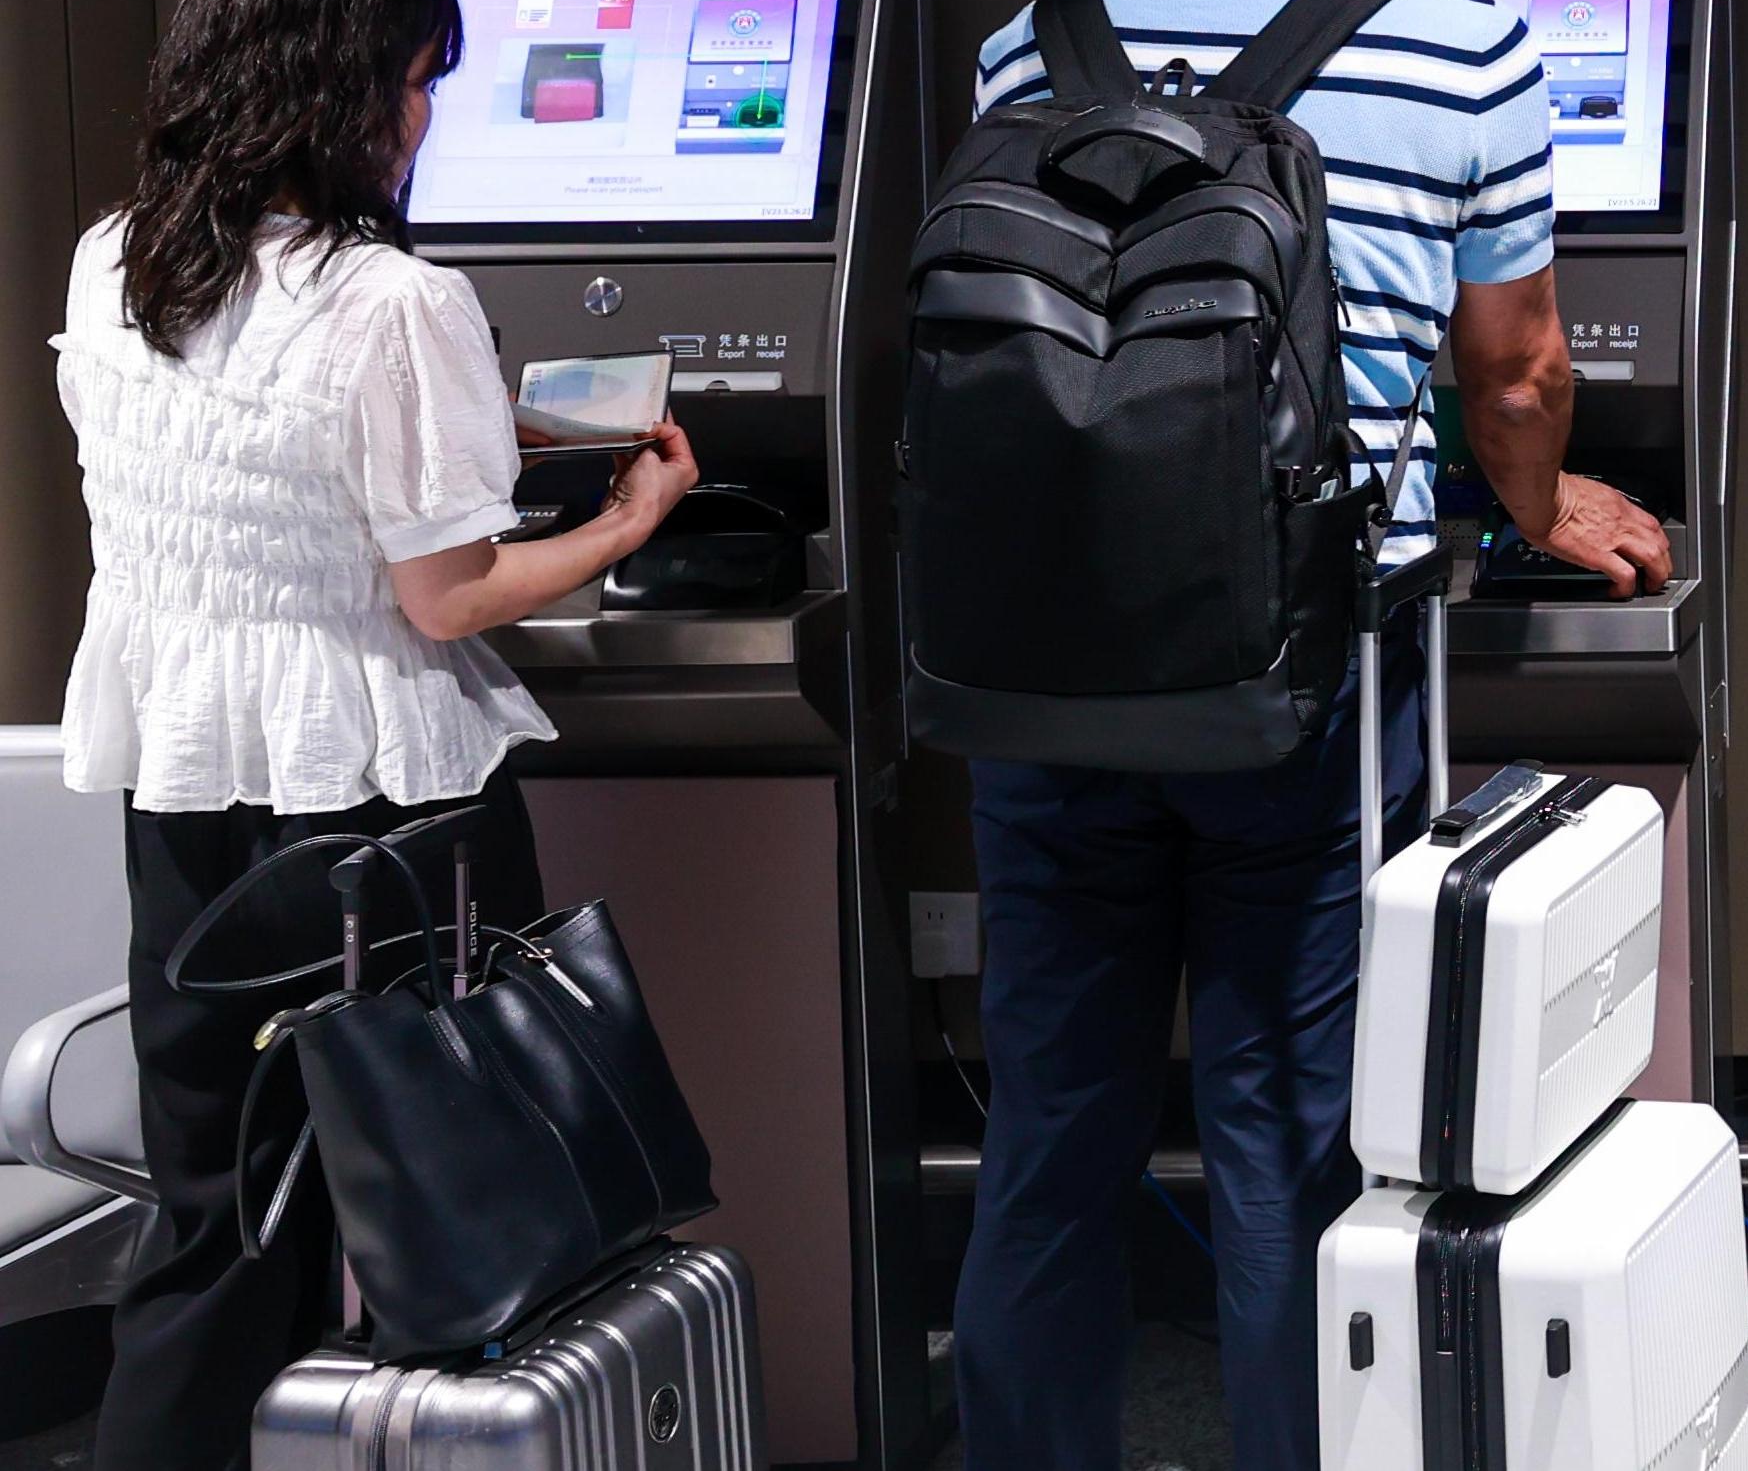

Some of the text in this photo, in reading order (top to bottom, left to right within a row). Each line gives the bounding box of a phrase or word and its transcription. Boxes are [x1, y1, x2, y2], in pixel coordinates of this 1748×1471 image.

[1572, 324, 1639, 337] 凭条出口
[719, 334, 786, 347] 凭条出口
[1571, 339, 1638, 349] Export receipt
[717, 349, 785, 359] Export receipt
[469, 901, 477, 958] POLICE
